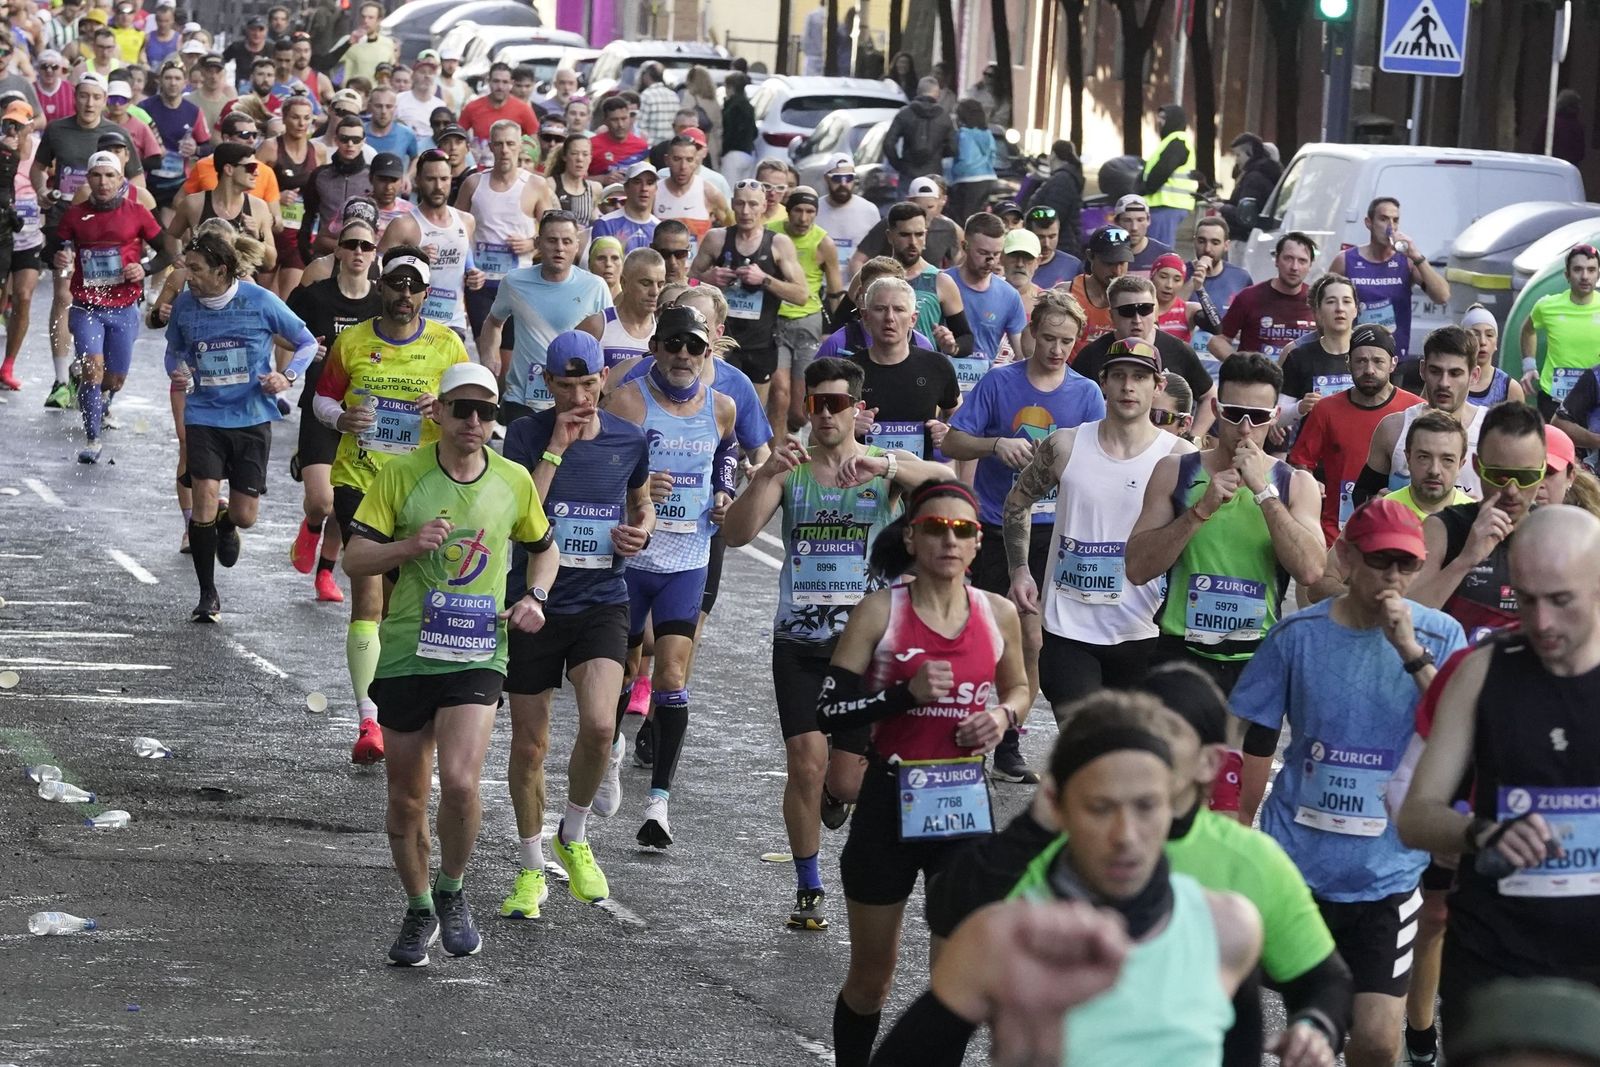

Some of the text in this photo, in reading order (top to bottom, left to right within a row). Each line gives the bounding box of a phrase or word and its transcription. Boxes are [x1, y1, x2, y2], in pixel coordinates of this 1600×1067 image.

[421, 308, 453, 319] EJANDRO
[1260, 329, 1310, 337] FINISHE
[210, 341, 239, 349] ZURICH
[387, 377, 428, 385] TRIATLÓN
[401, 385, 424, 393] REAL
[534, 389, 553, 399] STU
[383, 400, 416, 411] ZURICH
[381, 417, 400, 425] 6573
[397, 430, 411, 442] JR
[672, 476, 697, 485] URICH
[573, 506, 613, 517] ZURICH
[654, 503, 686, 518] GABO
[573, 526, 594, 535] 7105
[565, 538, 598, 552] FRED
[815, 544, 854, 552] ZURICH
[1077, 545, 1116, 553] ZURICH
[816, 563, 837, 571] 8996
[1077, 563, 1097, 572] 6576
[794, 580, 862, 590] ANDRÉS FREYRE
[1061, 570, 1115, 589] ANTOINE
[1216, 581, 1257, 595] ZURICH
[450, 597, 491, 609] ZURICH
[1215, 601, 1238, 612] 5979
[447, 617, 475, 629] 16220
[1195, 612, 1256, 631] ENRIQUE
[420, 630, 496, 649] DURANOSEVIC
[822, 690, 887, 718] ALMERIA
[1329, 750, 1383, 766] ZURICH
[934, 768, 977, 784] ZURICH
[1328, 775, 1356, 790] 7413
[937, 796, 962, 809] 7768
[1318, 791, 1364, 813] JOHN
[922, 812, 976, 833] ALICIA
